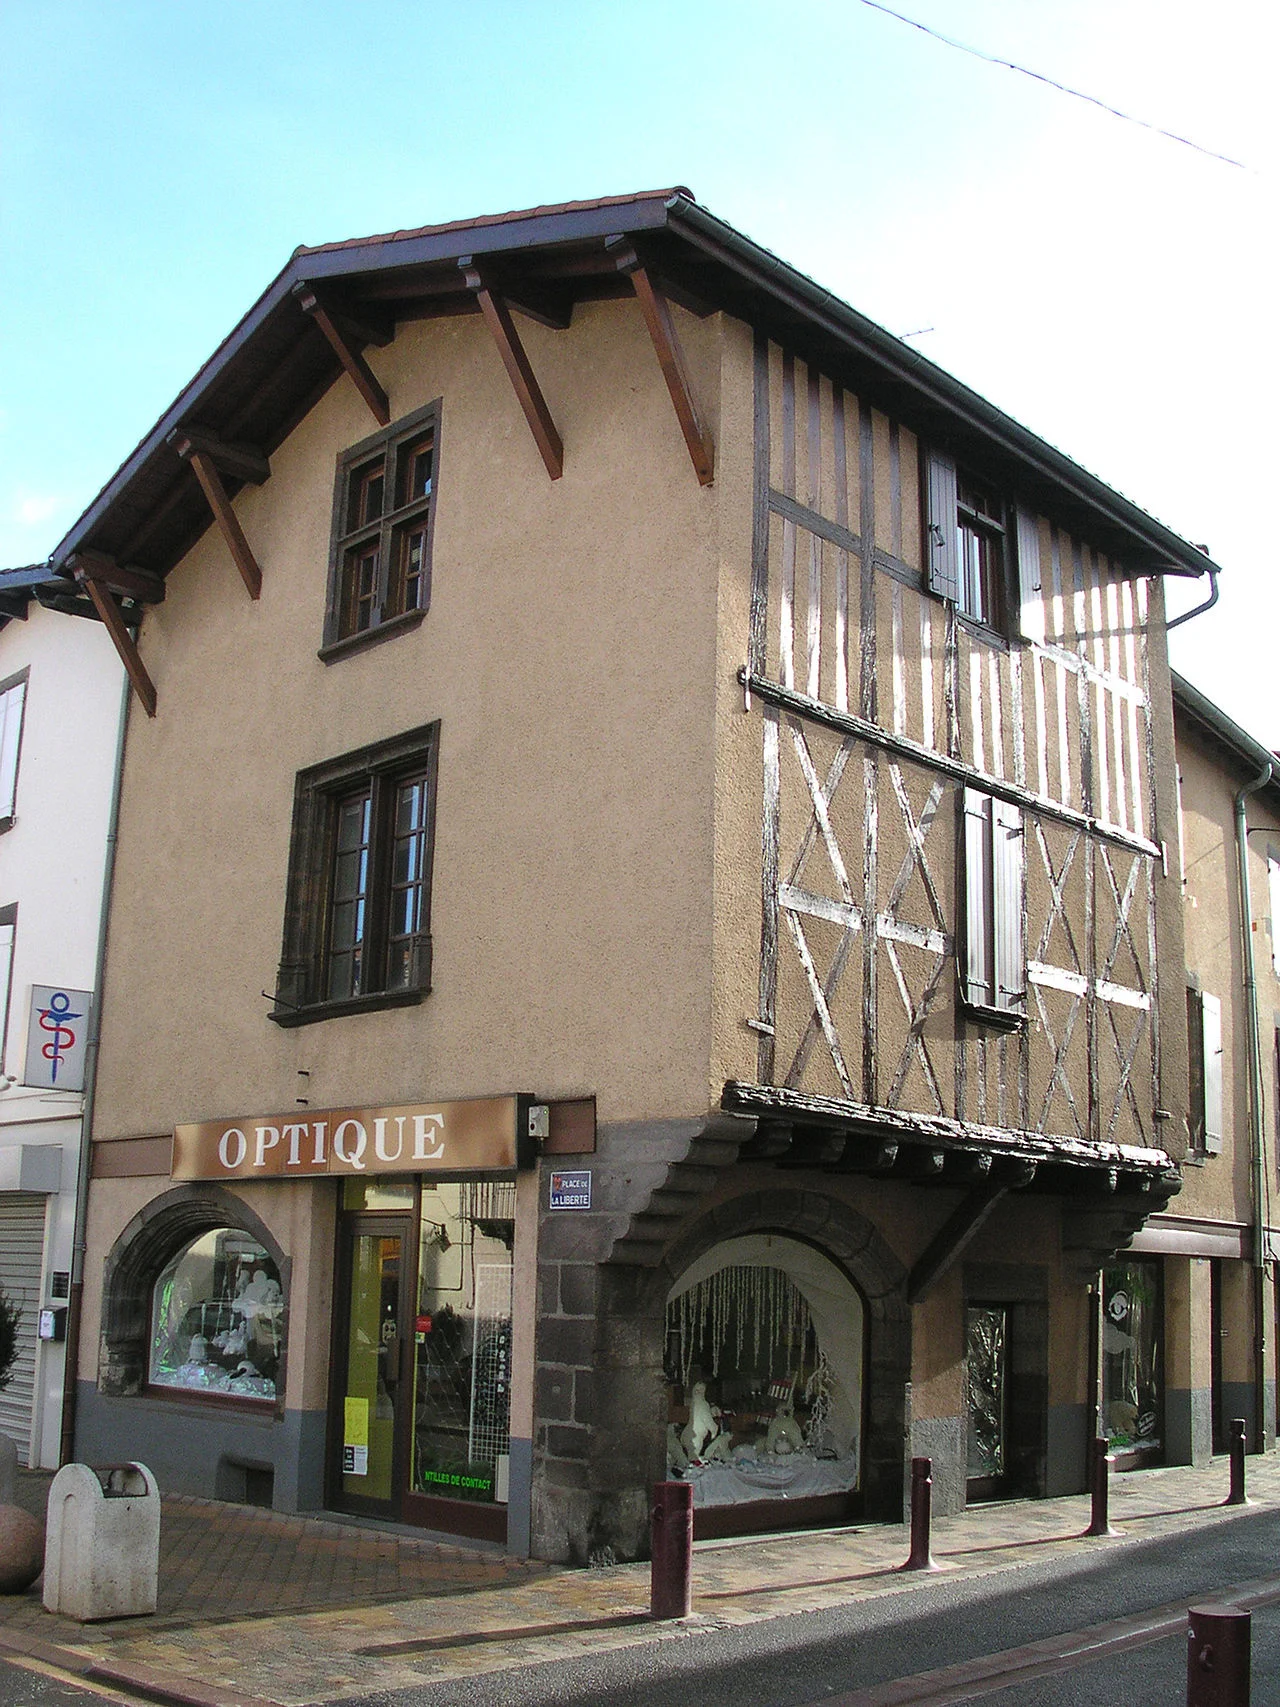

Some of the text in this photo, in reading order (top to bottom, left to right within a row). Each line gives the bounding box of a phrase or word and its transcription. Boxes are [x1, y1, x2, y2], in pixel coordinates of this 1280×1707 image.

[218, 1113, 445, 1169] OPTIQUE
[562, 1179, 580, 1188] PLACE
[551, 1197, 559, 1205] LA
[425, 1471, 491, 1490] NTILLES DE CONTACT
